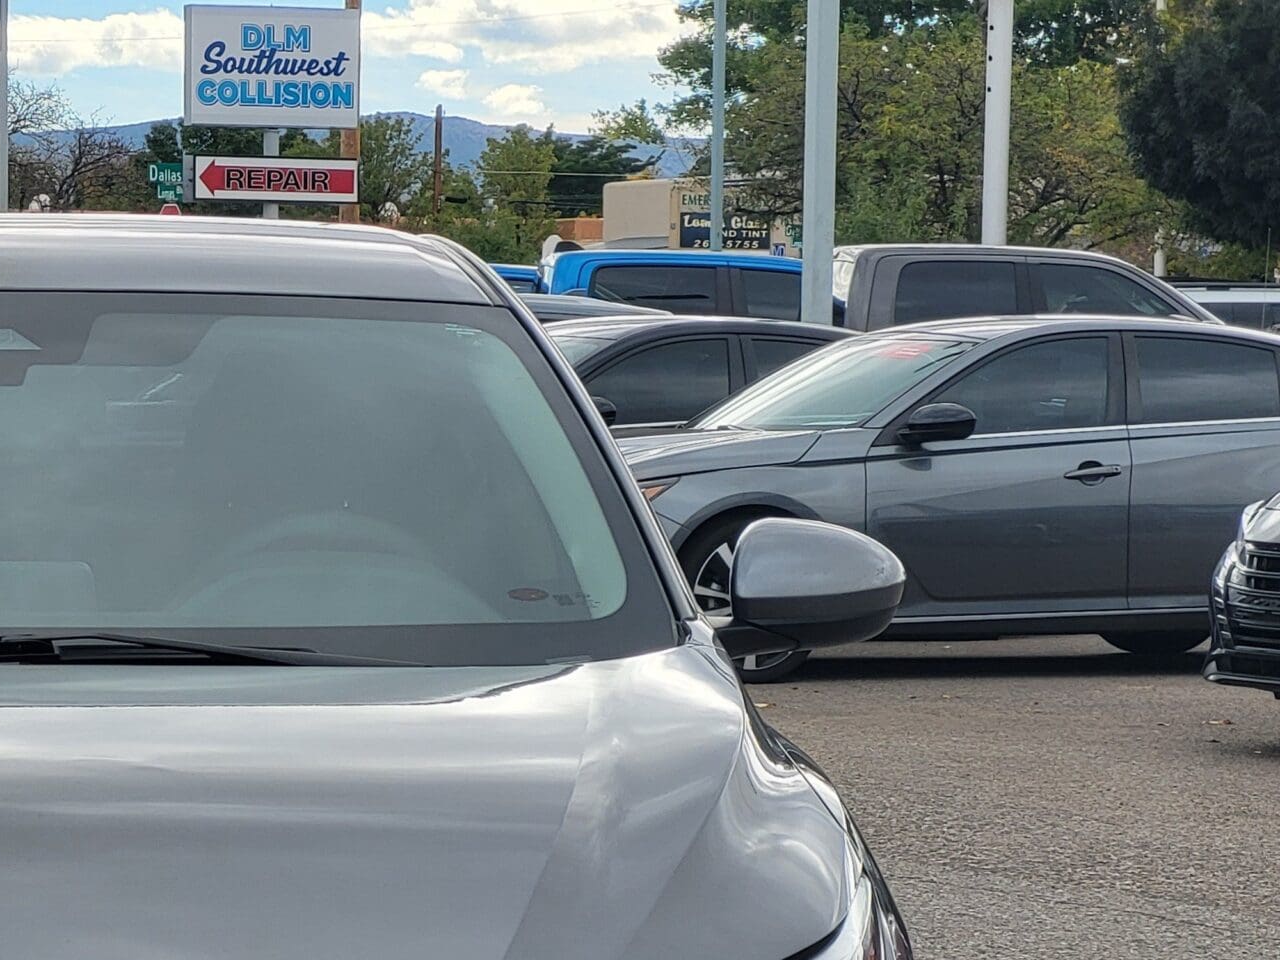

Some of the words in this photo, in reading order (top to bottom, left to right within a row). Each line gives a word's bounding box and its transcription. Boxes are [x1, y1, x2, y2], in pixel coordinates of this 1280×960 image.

[241, 23, 311, 52] DLM
[200, 41, 350, 76] Southwest
[196, 78, 354, 108] COLLISION
[149, 164, 182, 182] Dallas
[225, 168, 330, 192] REPAIR
[741, 230, 768, 238] TINT
